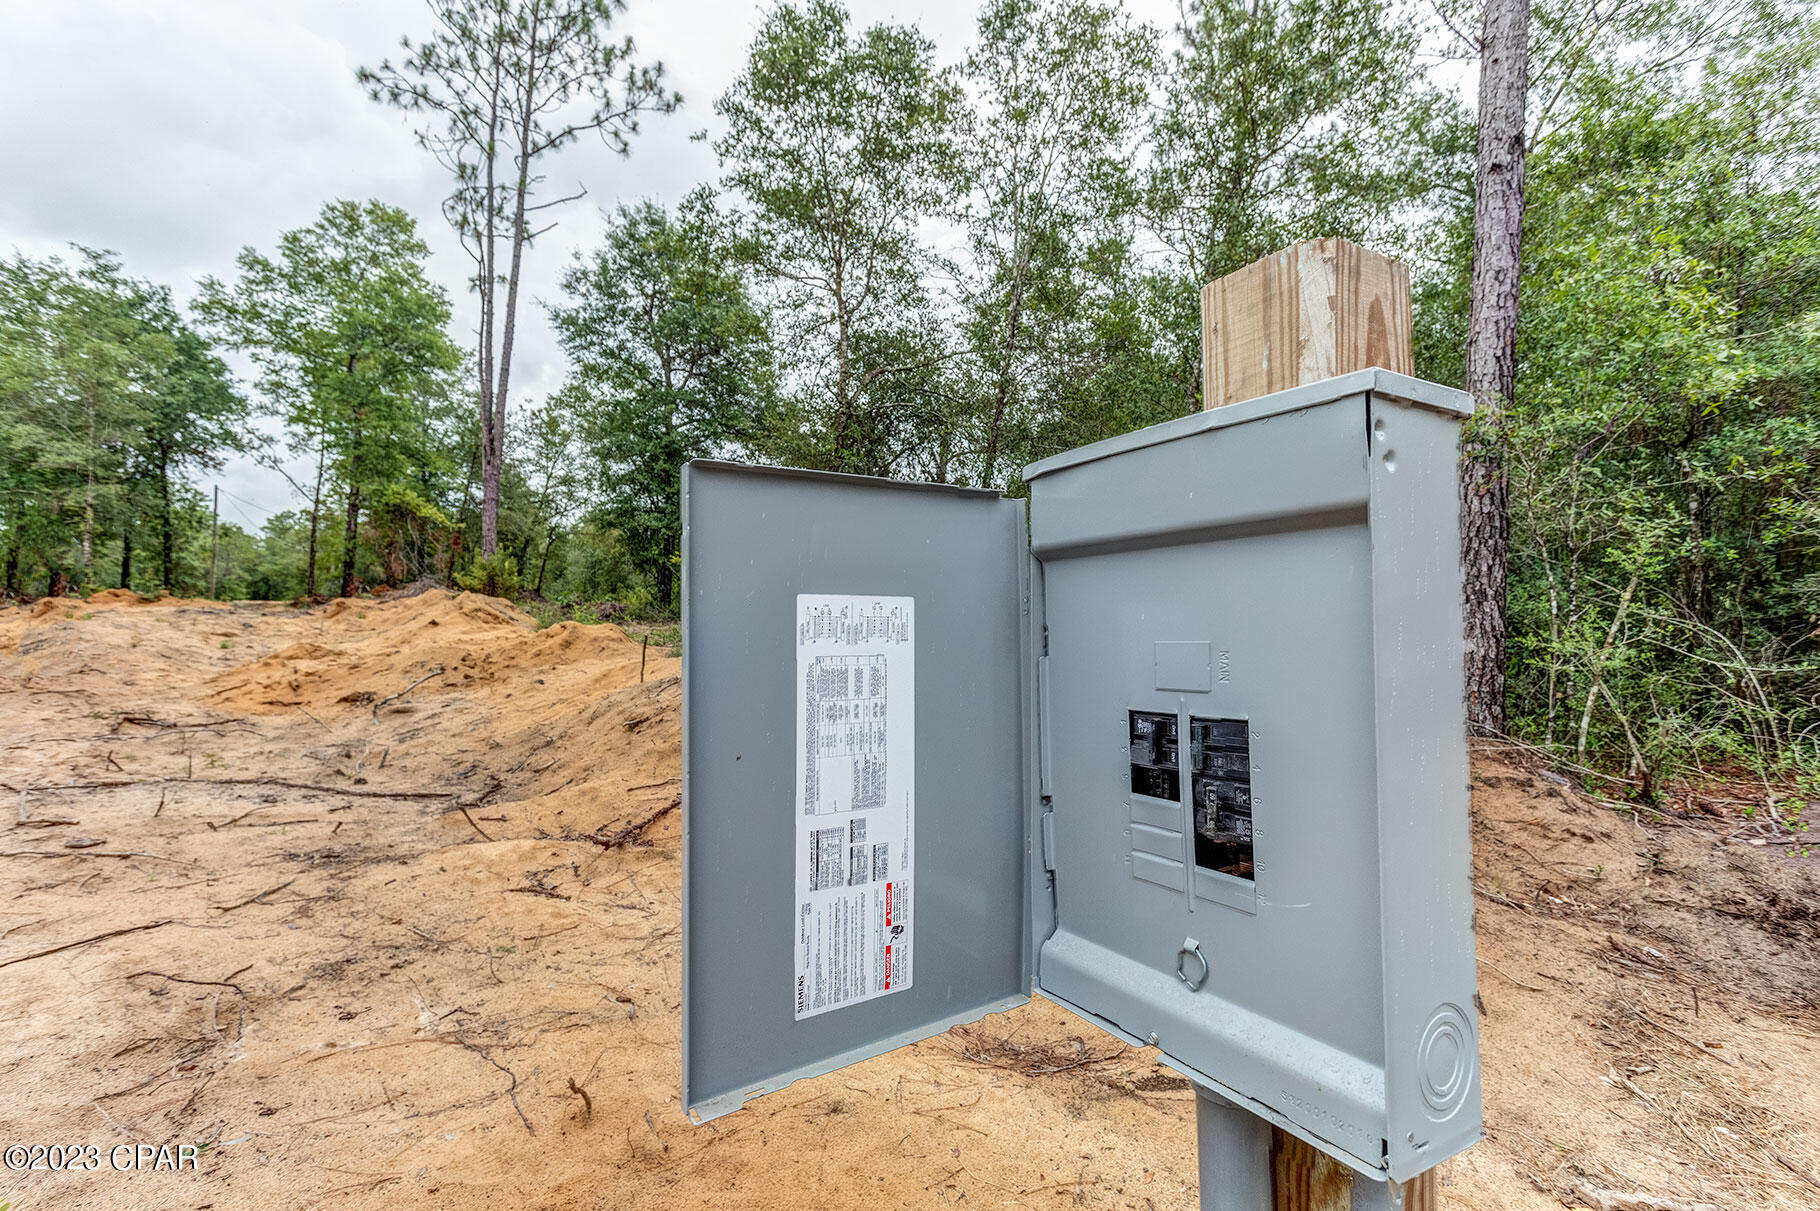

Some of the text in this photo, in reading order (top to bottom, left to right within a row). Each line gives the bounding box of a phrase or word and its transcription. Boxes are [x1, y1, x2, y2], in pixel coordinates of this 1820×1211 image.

[1218, 649, 1230, 684] MAIN
[1251, 730, 1262, 740] 2
[1253, 797, 1262, 806] 6
[1254, 829, 1264, 838] 8
[1256, 860, 1266, 872] 10
